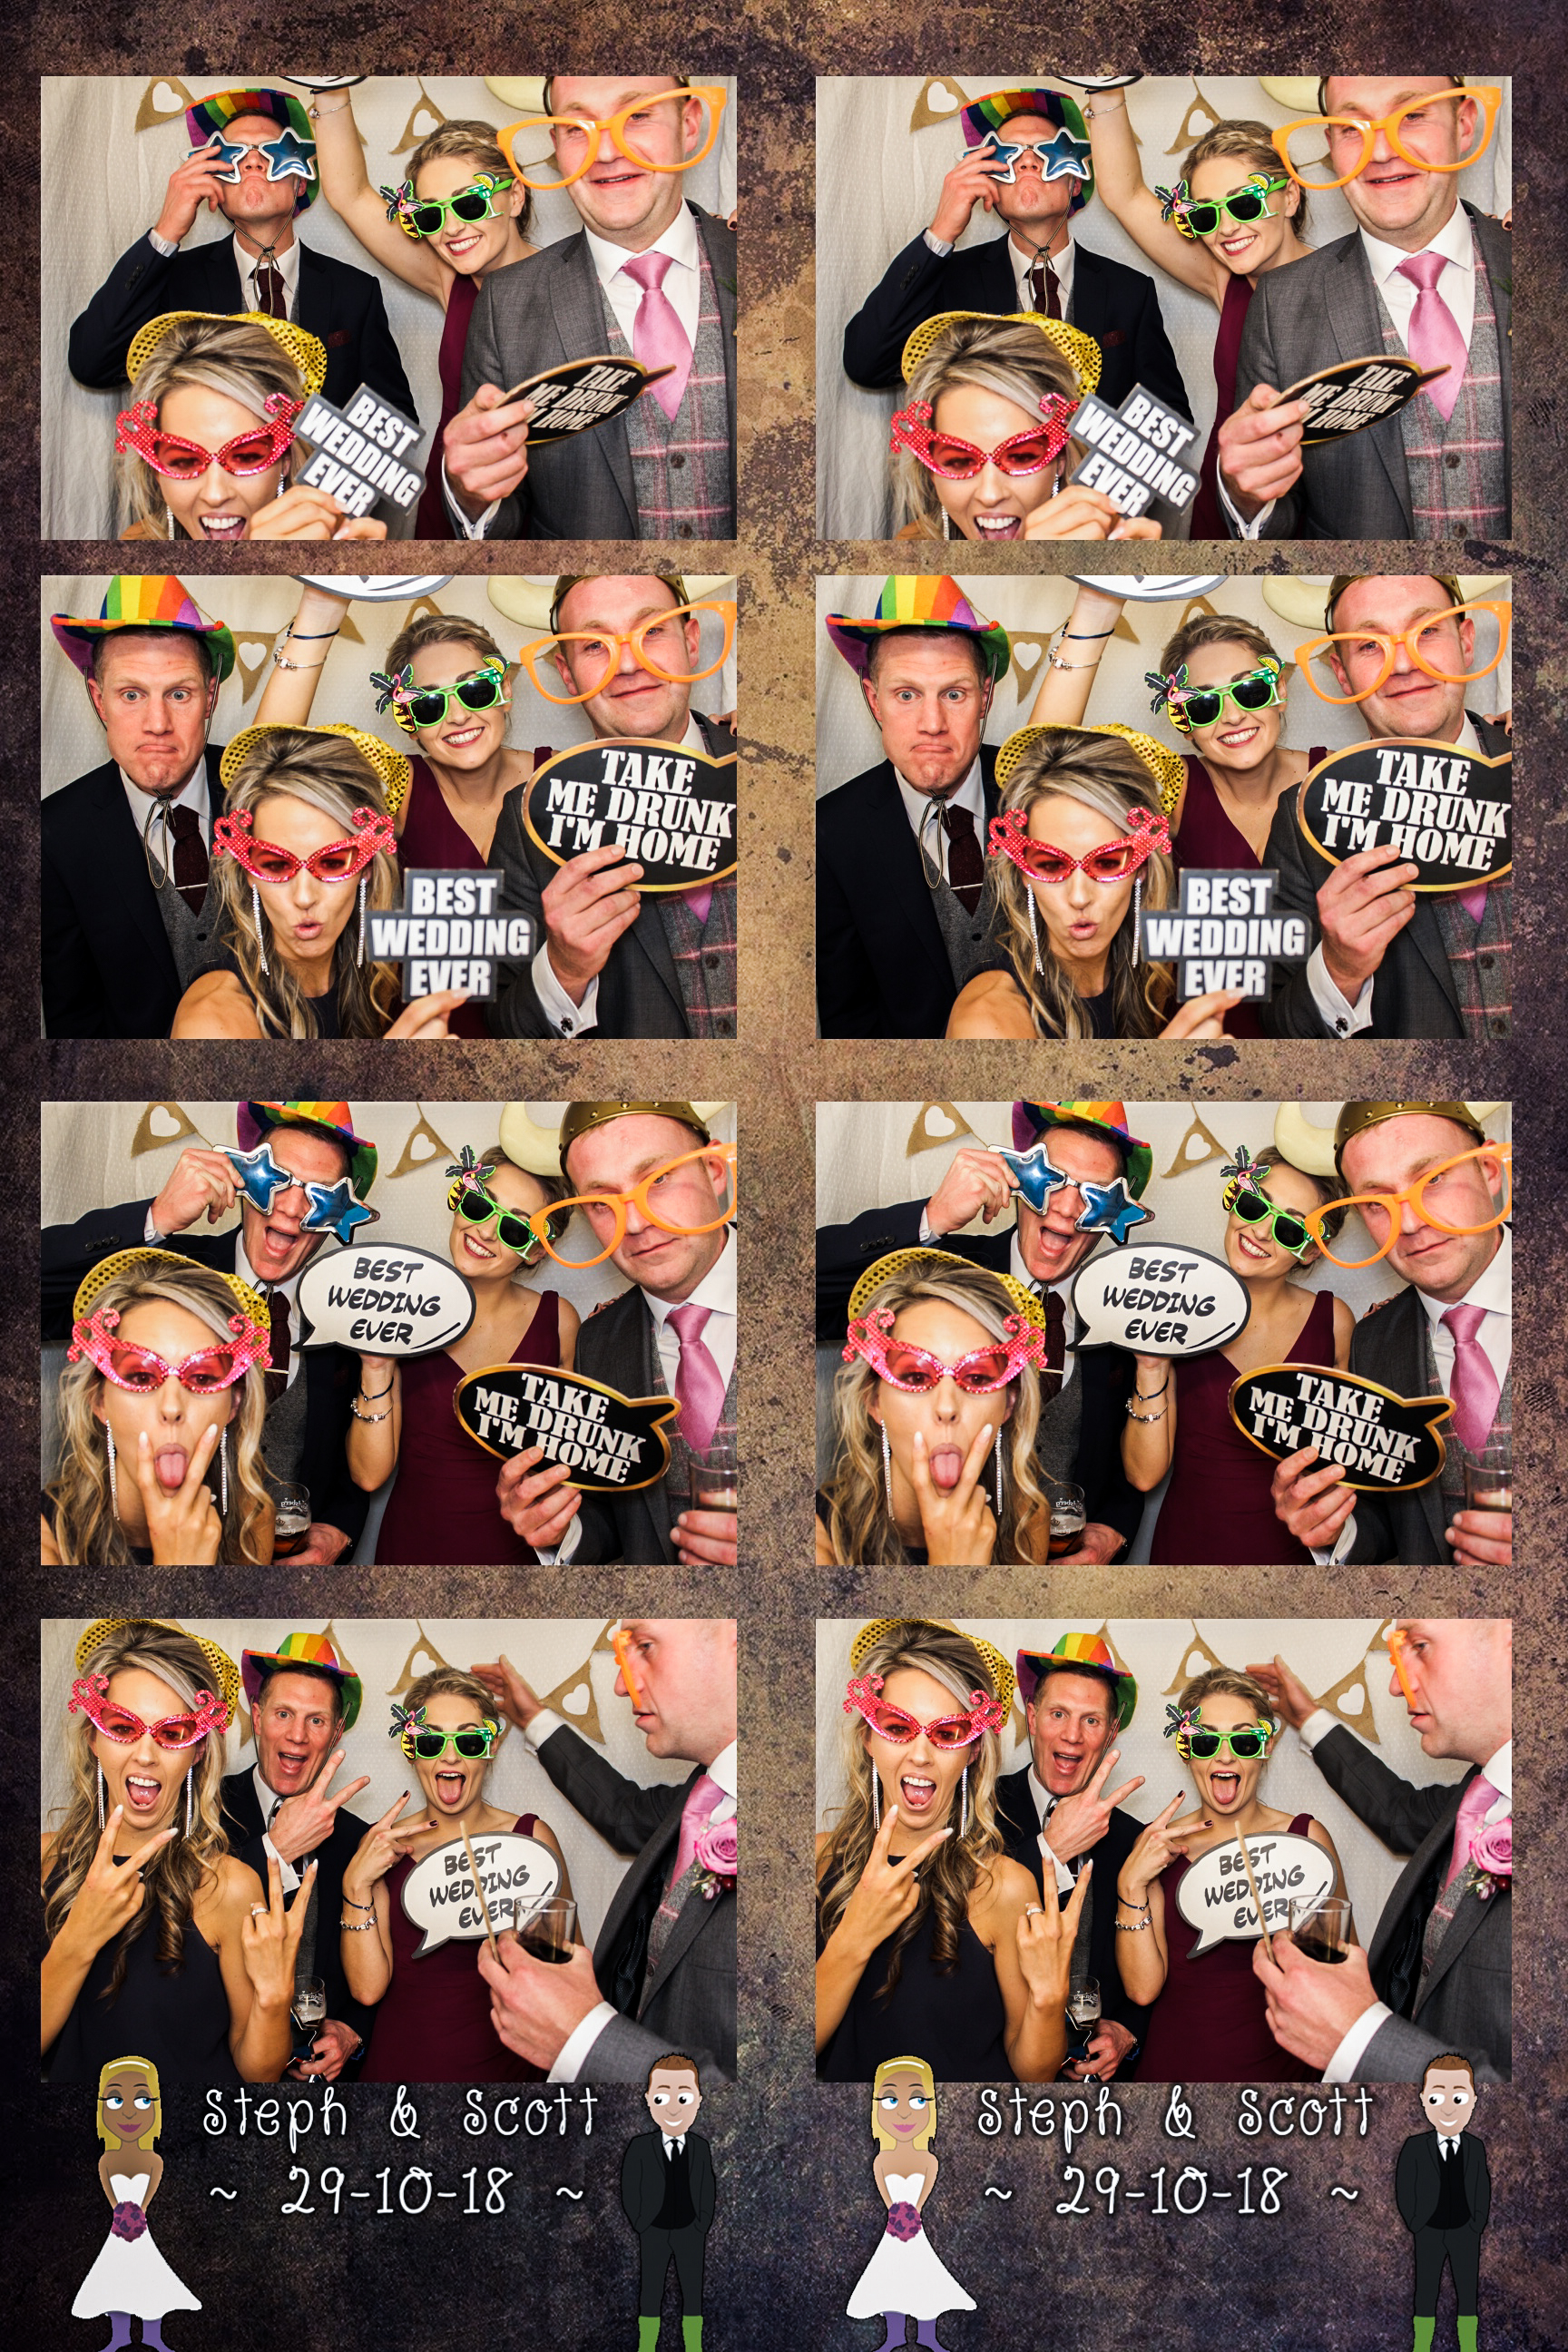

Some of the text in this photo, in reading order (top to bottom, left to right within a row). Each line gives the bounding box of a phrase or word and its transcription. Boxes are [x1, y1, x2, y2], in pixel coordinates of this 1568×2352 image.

[573, 364, 637, 392] TAKE
[1348, 364, 1412, 392] TAKE
[524, 382, 629, 414] ME DRUNK
[1299, 382, 1404, 414] ME DRUNK
[347, 393, 420, 458] BEST
[532, 408, 601, 431] HOME
[1122, 393, 1195, 458] BEST
[1307, 408, 1376, 431] HOME
[299, 402, 422, 507] WEDDING
[1074, 402, 1197, 507] WEDDING
[303, 452, 376, 518] EVER
[1078, 452, 1151, 518] EVER
[601, 749, 696, 796] TAKE
[1376, 749, 1471, 796] TAKE
[545, 778, 737, 838] ME DRUNK
[1320, 778, 1512, 838] ME DRUNK
[546, 814, 721, 871] I'M HOME
[1321, 814, 1496, 871] I'M HOME
[411, 877, 497, 916] BEST
[1186, 877, 1272, 916] BEST
[371, 918, 531, 956] WEDDING
[1146, 918, 1306, 956] WEDDING
[409, 959, 492, 996] EVER
[1184, 959, 1267, 996] EVER
[353, 1256, 424, 1284] BEST
[1128, 1256, 1199, 1284] BEST
[328, 1285, 441, 1317] WEDDING
[1102, 1285, 1216, 1317] WEDDING
[349, 1318, 414, 1345] EVER
[1124, 1318, 1189, 1345] EVER
[521, 1372, 610, 1424] TAKE
[1296, 1372, 1385, 1424] TAKE
[474, 1386, 647, 1464] ME DRUNK
[1249, 1386, 1422, 1464] ME DRUNK
[476, 1413, 632, 1484] I'M HOME
[1251, 1413, 1406, 1484] I'M HOME
[444, 1842, 502, 1876] BEST
[1219, 1842, 1277, 1876] BEST
[429, 1865, 531, 1907] WEDDING
[1204, 1865, 1306, 1907] WEDDING
[458, 1897, 517, 1929] EVER
[1233, 1897, 1292, 1929] EVER
